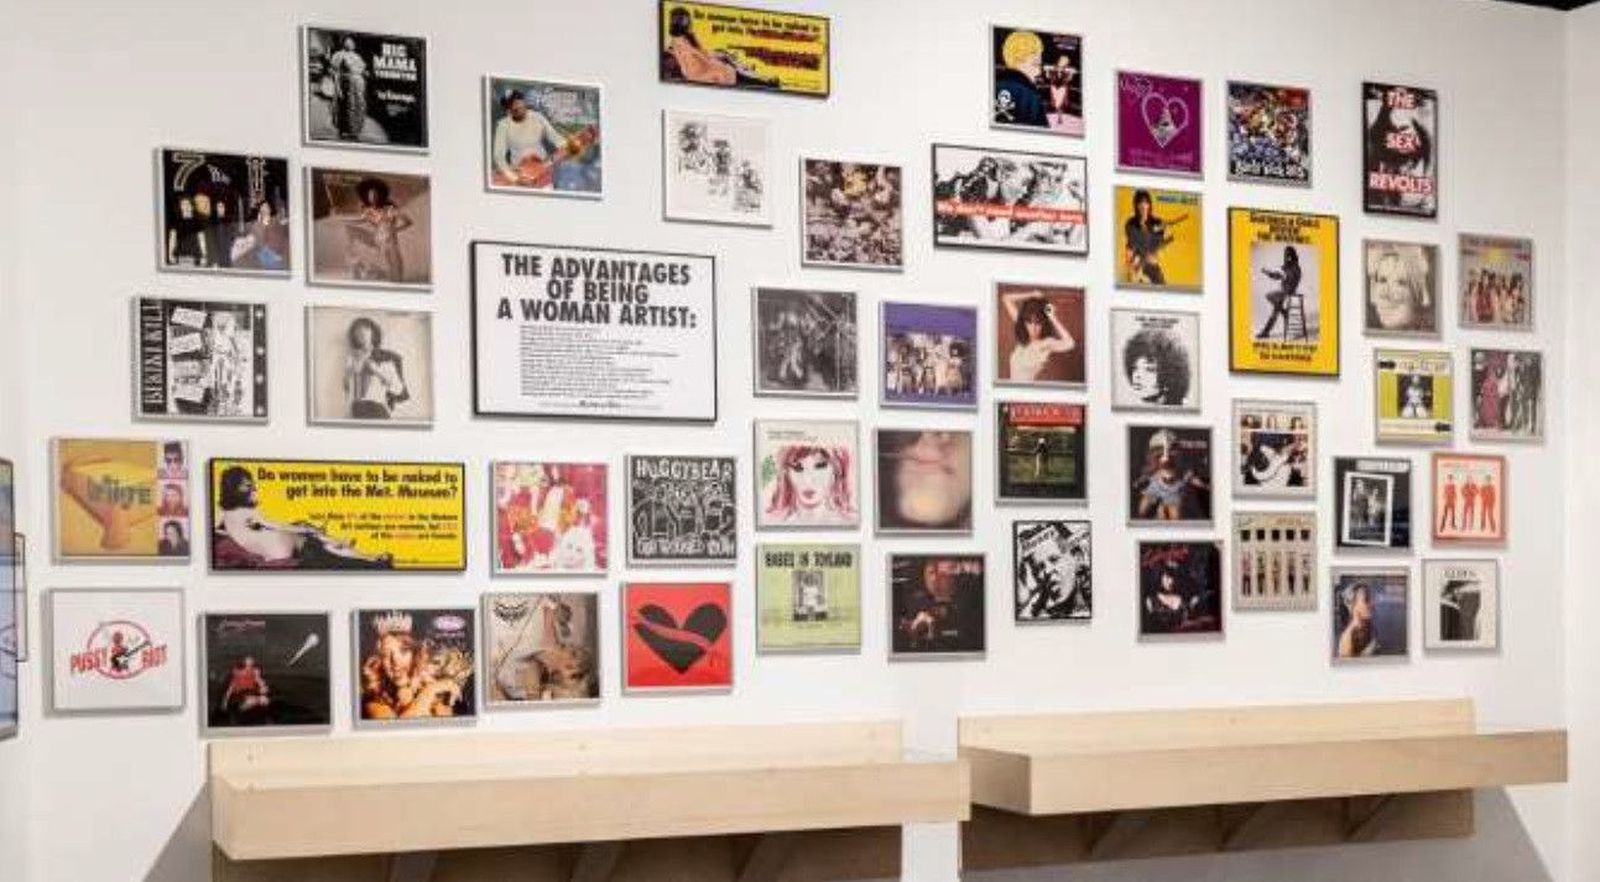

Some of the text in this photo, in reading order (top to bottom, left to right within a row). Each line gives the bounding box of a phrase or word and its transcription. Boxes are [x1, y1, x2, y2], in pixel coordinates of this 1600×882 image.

[373, 54, 417, 72] MAMA
[1386, 89, 1415, 109] THE
[1386, 132, 1419, 153] SEX
[172, 152, 205, 192] 7
[1369, 172, 1433, 196] REVOLTS
[501, 254, 691, 286] THE ADVANTAGES
[547, 280, 650, 304] OF BEING
[497, 298, 697, 328] A WOMAN ARTIST:
[257, 467, 458, 483] Do women have to be naked to
[286, 484, 458, 500] get into the Met. Museum?
[765, 551, 853, 568] BABES IN TOYLAND
[70, 646, 107, 674] PUSSY
